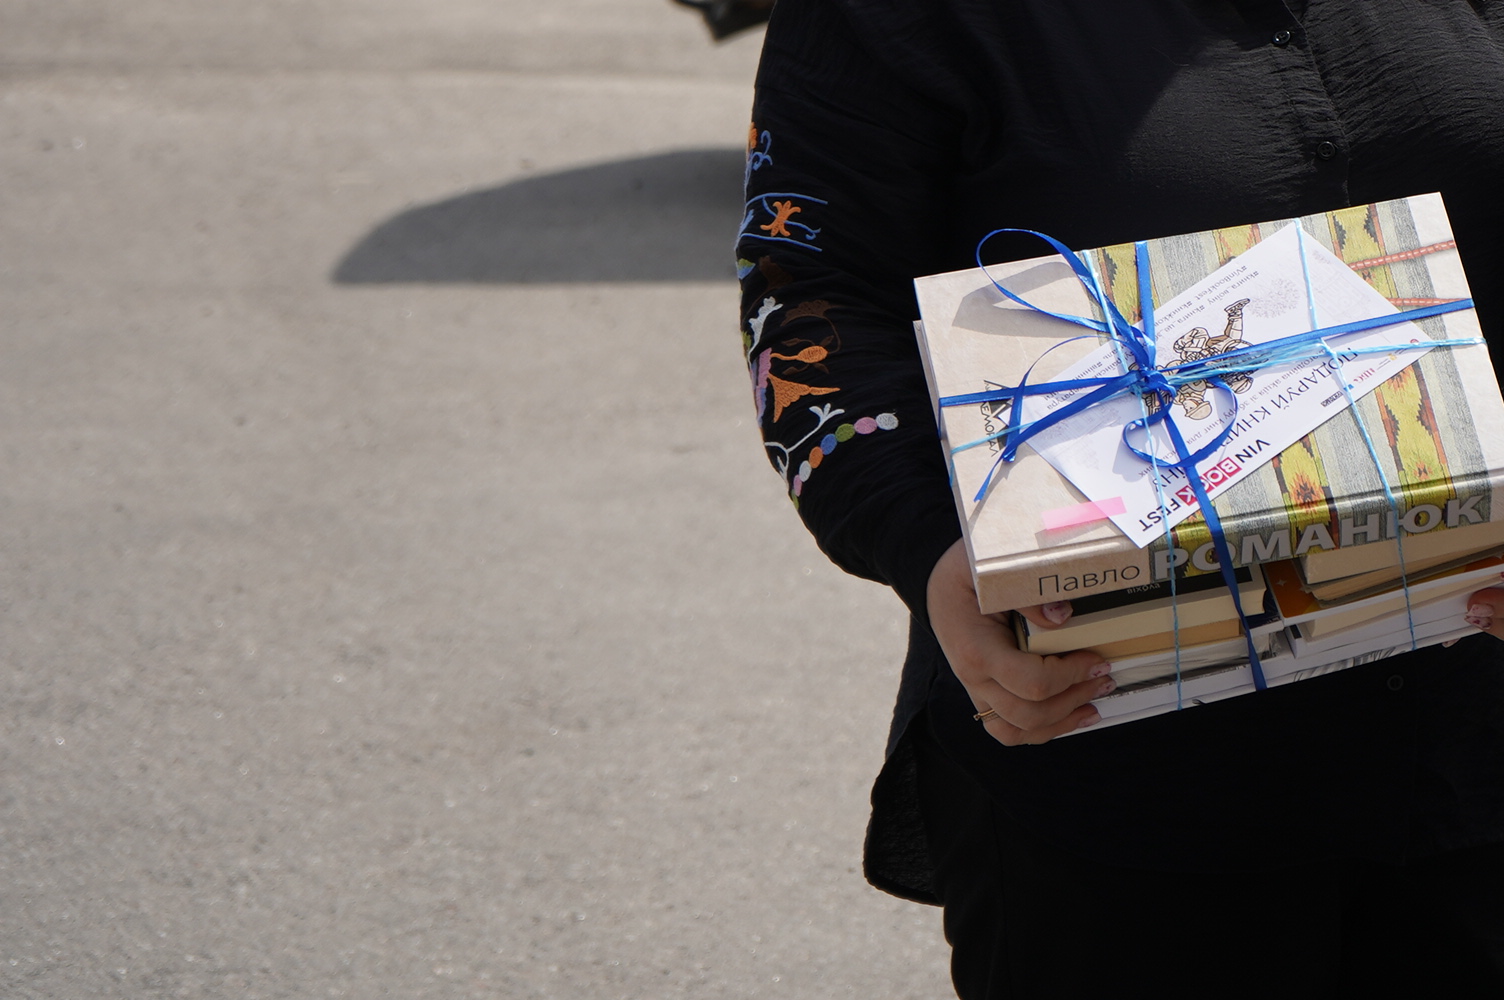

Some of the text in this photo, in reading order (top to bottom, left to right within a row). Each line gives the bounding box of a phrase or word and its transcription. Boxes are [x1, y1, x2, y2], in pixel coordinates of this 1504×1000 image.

[1257, 377, 1282, 397] акція
[1269, 347, 1358, 409] ПОДАРУЙ
[1222, 398, 1250, 420] збру
[1201, 416, 1224, 434] книг
[1233, 439, 1271, 464] VIN
[1137, 497, 1181, 532] FEST
[1037, 493, 1488, 597] Павло РОМАНЮК
